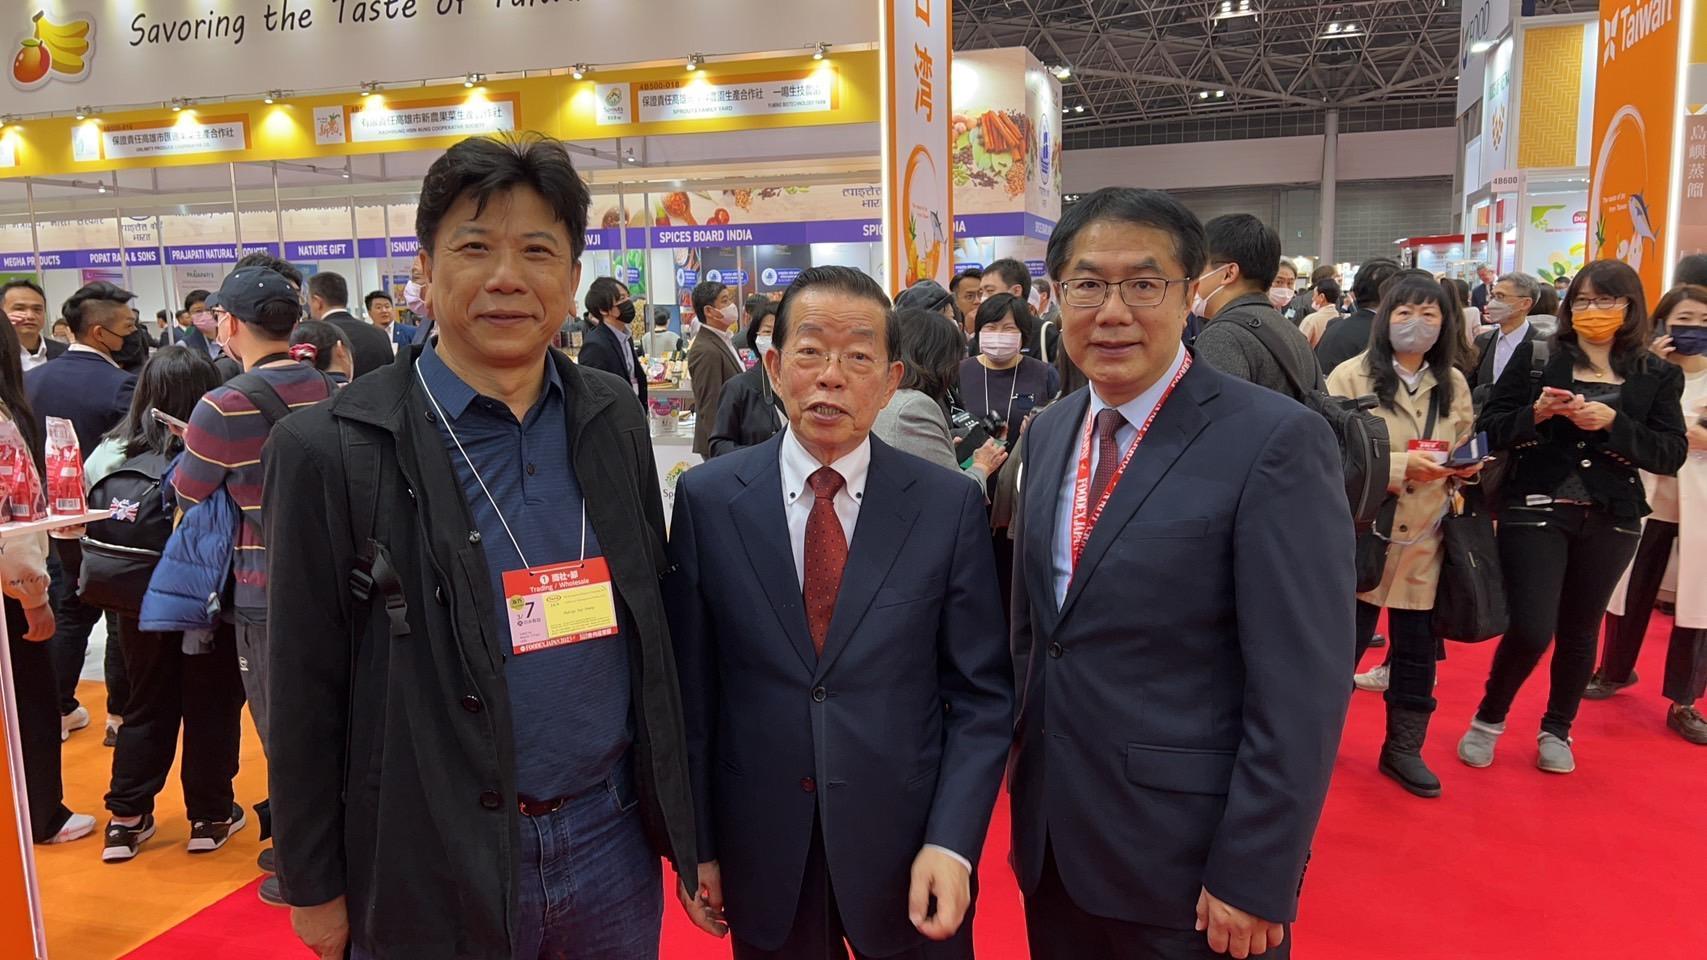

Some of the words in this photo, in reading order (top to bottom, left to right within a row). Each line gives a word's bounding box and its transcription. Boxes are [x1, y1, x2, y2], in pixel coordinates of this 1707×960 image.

[130, 11, 245, 46] Savoring
[264, 0, 312, 31] the
[1620, 0, 1672, 52] Taiwan
[659, 231, 691, 243] SPICES
[693, 230, 724, 242] BOARD
[726, 229, 753, 241] INDIA
[172, 248, 205, 261] PRAJAPATI
[205, 247, 235, 259] NATURAL
[298, 245, 327, 257] NATURE
[329, 243, 346, 255] GIFT
[4, 256, 26, 267] MEGHA
[27, 255, 61, 266] PRDUCTS
[90, 253, 111, 264] POPAT
[112, 252, 131, 263] RAA
[131, 252, 136, 262] &
[137, 251, 157, 262] SONS
[663, 488, 674, 500] Sp
[529, 585, 554, 593] Trading
[559, 578, 590, 589] Wholesale
[525, 601, 535, 618] 7
